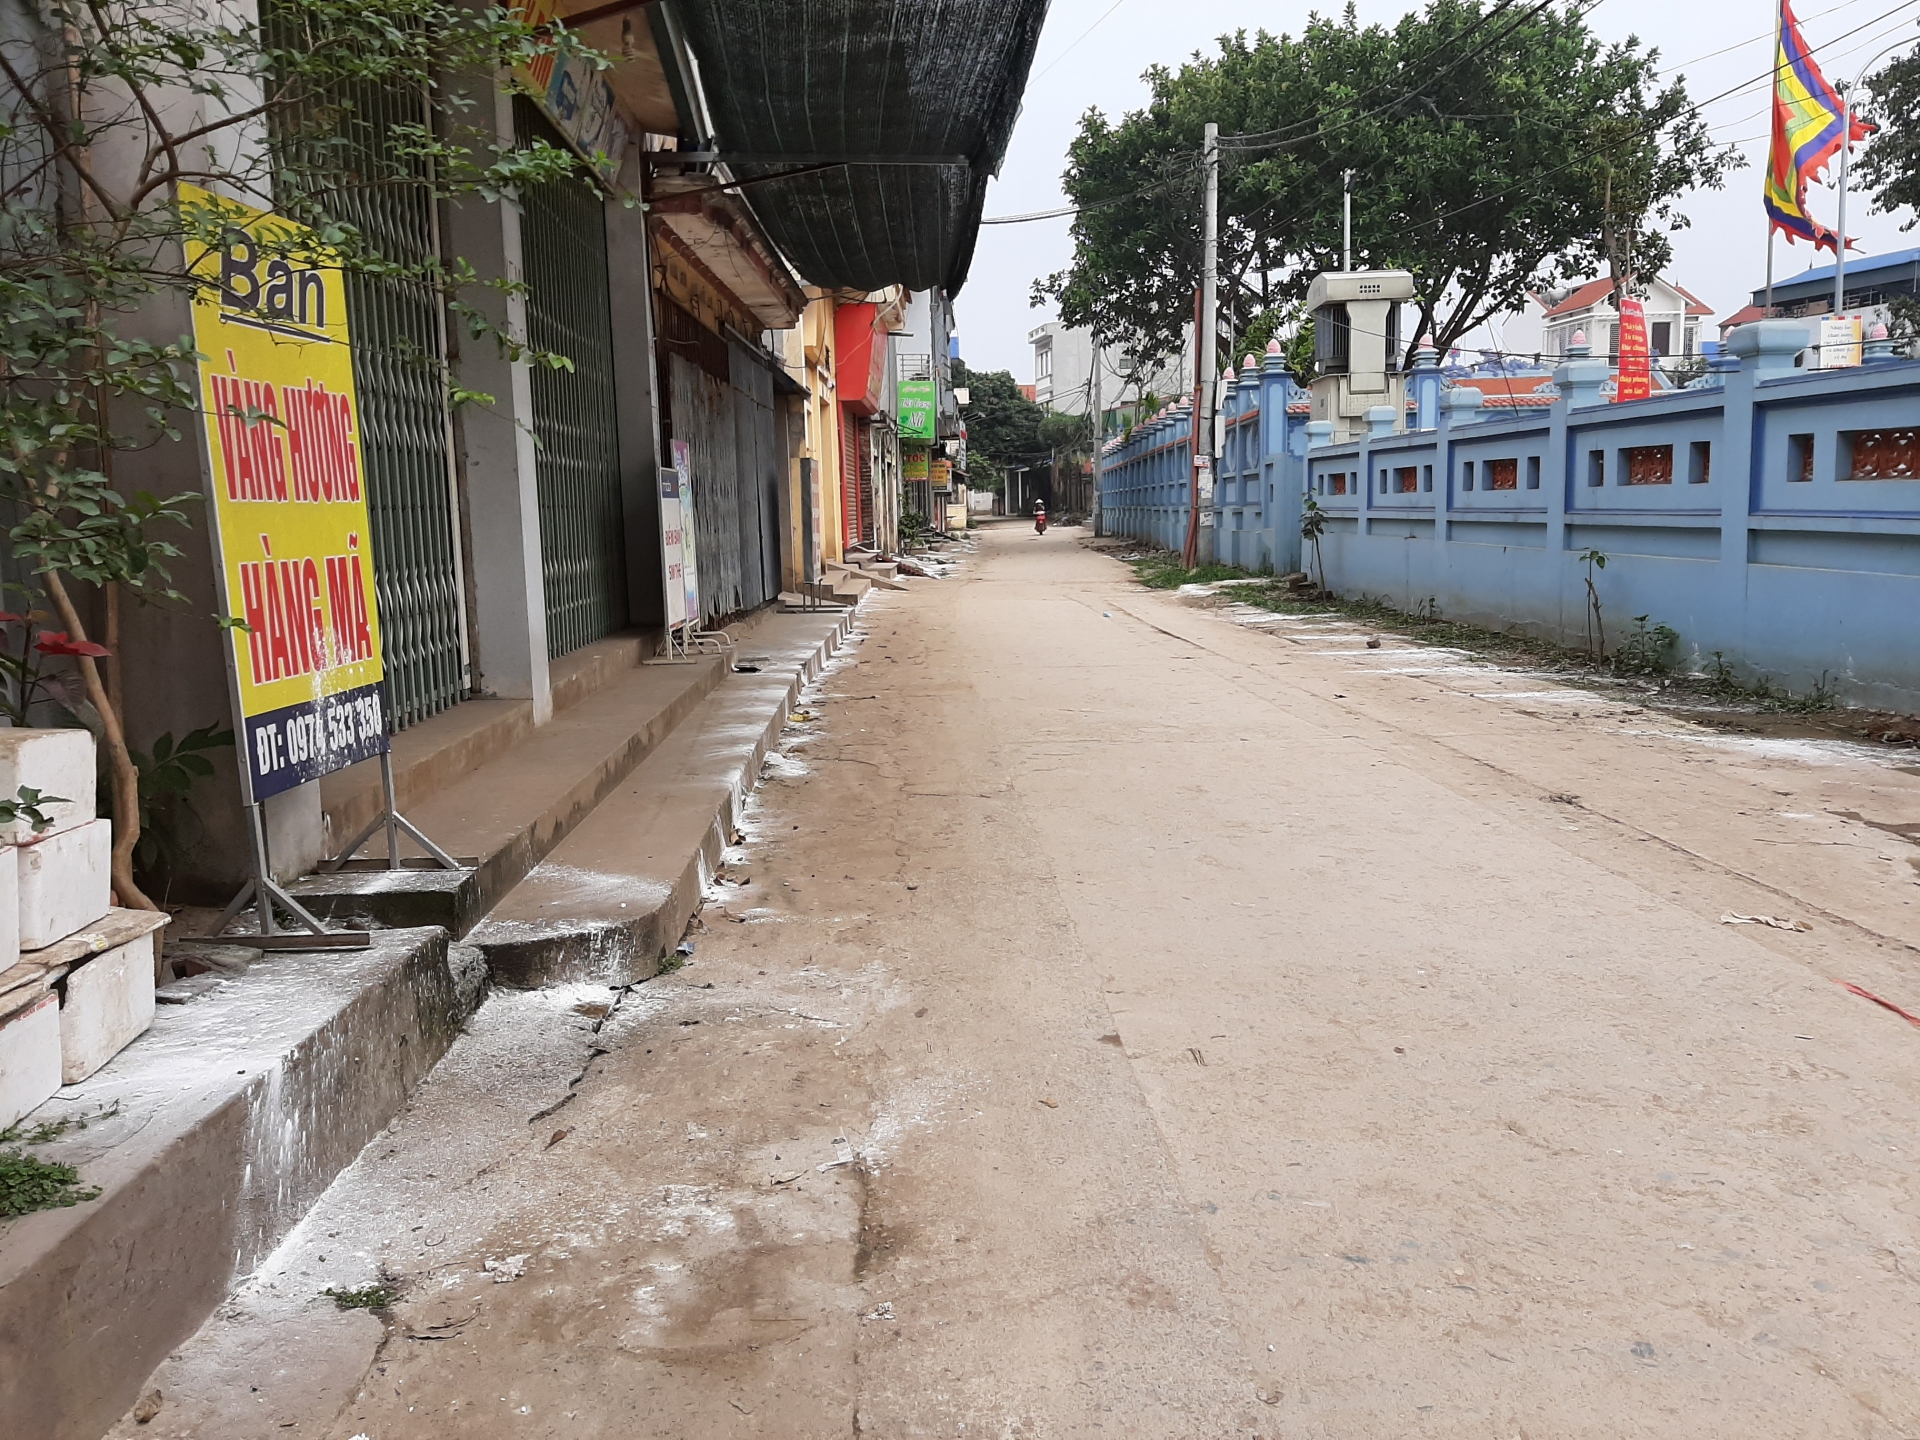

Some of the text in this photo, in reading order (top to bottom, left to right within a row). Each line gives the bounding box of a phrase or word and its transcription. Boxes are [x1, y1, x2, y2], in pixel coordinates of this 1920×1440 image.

[210, 348, 361, 504] VÀNG HƯƠNG
[238, 530, 373, 687] HÀNG MÃ
[255, 723, 285, 776] ĐT:
[327, 702, 355, 751] 533
[355, 691, 382, 741] 350
